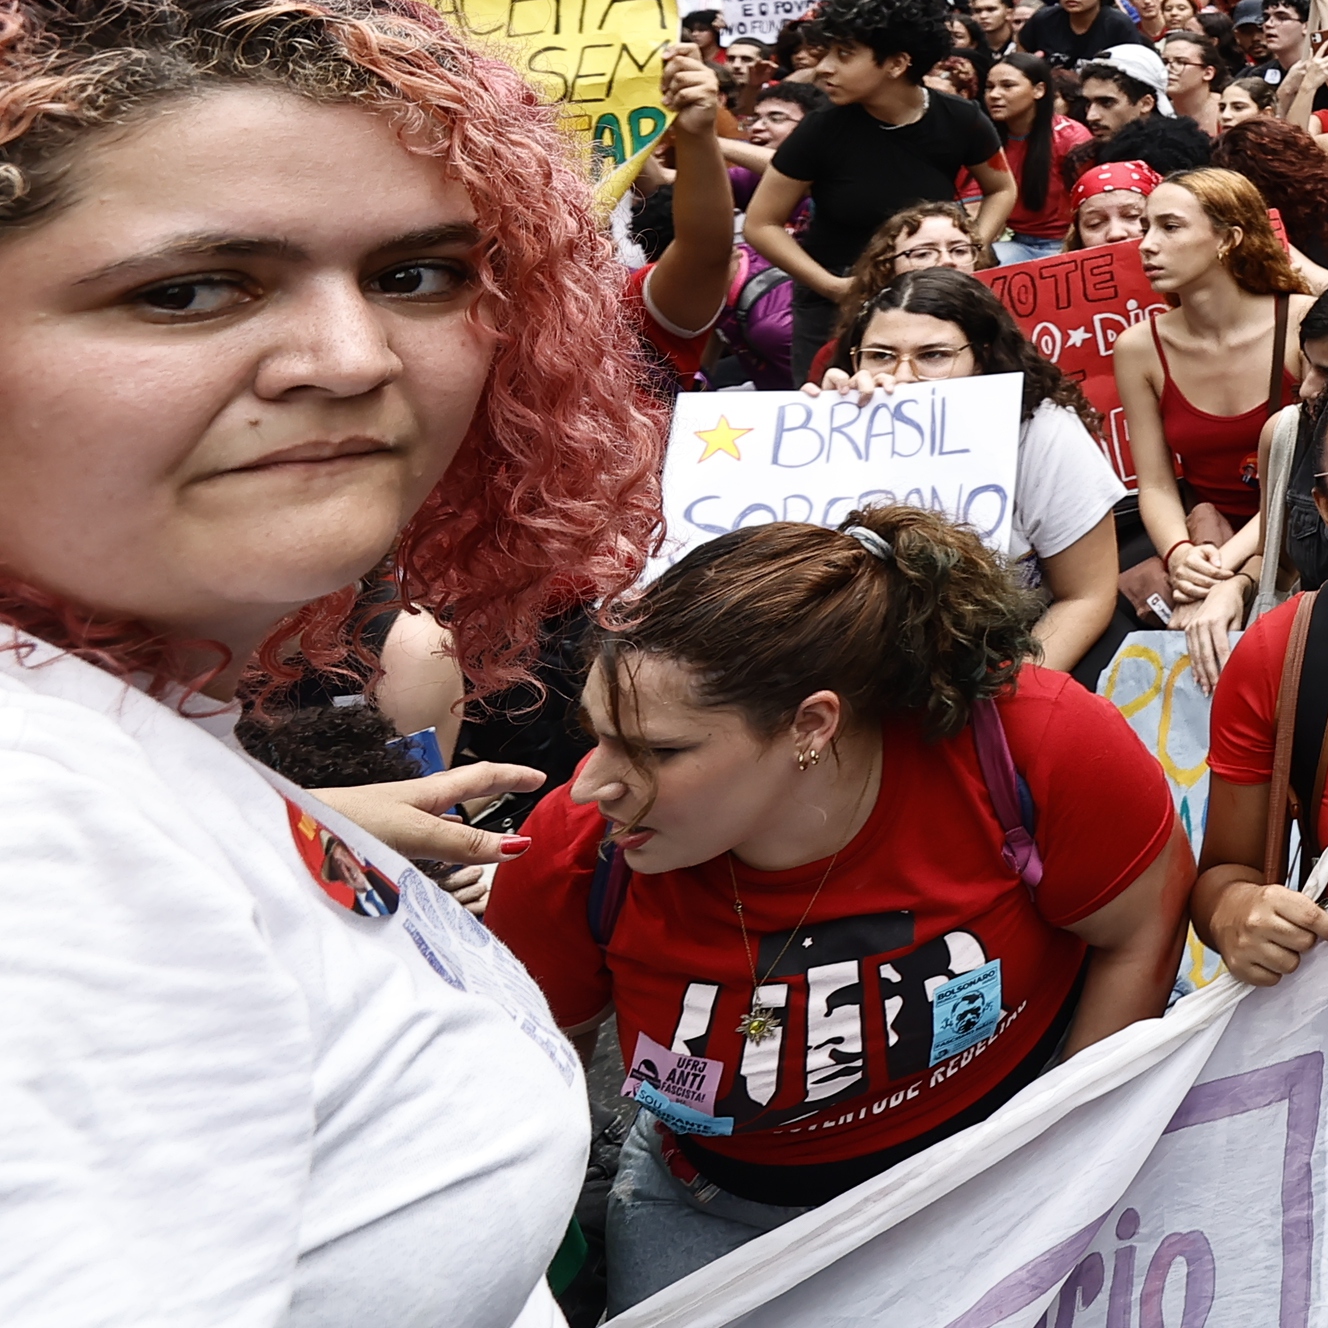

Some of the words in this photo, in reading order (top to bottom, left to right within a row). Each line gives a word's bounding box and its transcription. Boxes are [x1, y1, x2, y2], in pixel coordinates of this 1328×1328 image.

[937, 968, 996, 1000] BOLSONARO
[677, 1056, 709, 1074] UFRJ
[666, 1068, 708, 1092] ANTI
[638, 1089, 664, 1110] SOU
[659, 1081, 707, 1104] FASCISTA!
